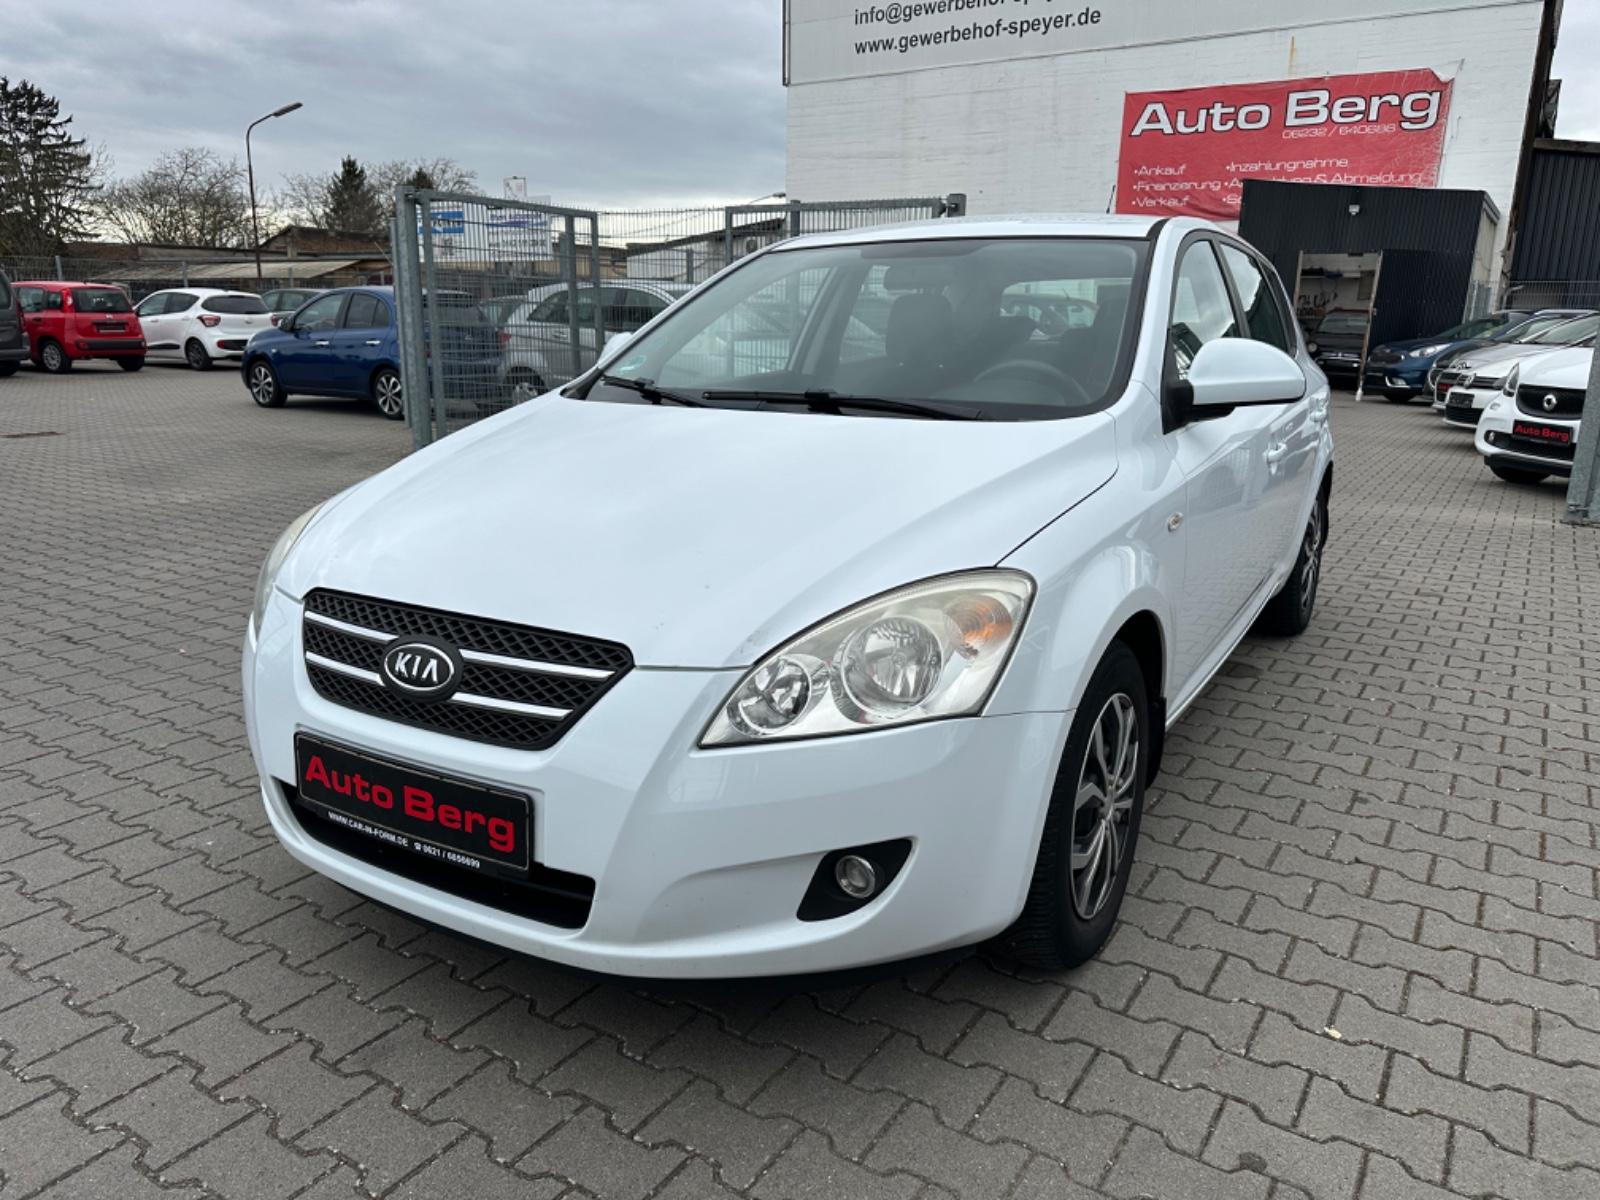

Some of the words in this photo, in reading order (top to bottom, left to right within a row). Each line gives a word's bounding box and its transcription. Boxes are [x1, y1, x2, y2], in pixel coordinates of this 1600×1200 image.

[854, 7, 1101, 54] www.gewerbehof-speyer.de
[1129, 101, 1272, 138] Auto
[1284, 88, 1443, 131] Berg
[1138, 163, 1187, 176] Ankauf
[1229, 157, 1349, 173] Inzahlungnahme
[1136, 195, 1190, 207] Verkauf
[1514, 424, 1540, 437] Auto
[1541, 427, 1569, 442] Berg
[394, 651, 439, 683] KIA
[305, 755, 393, 809] Auto
[403, 785, 516, 853] Berg
